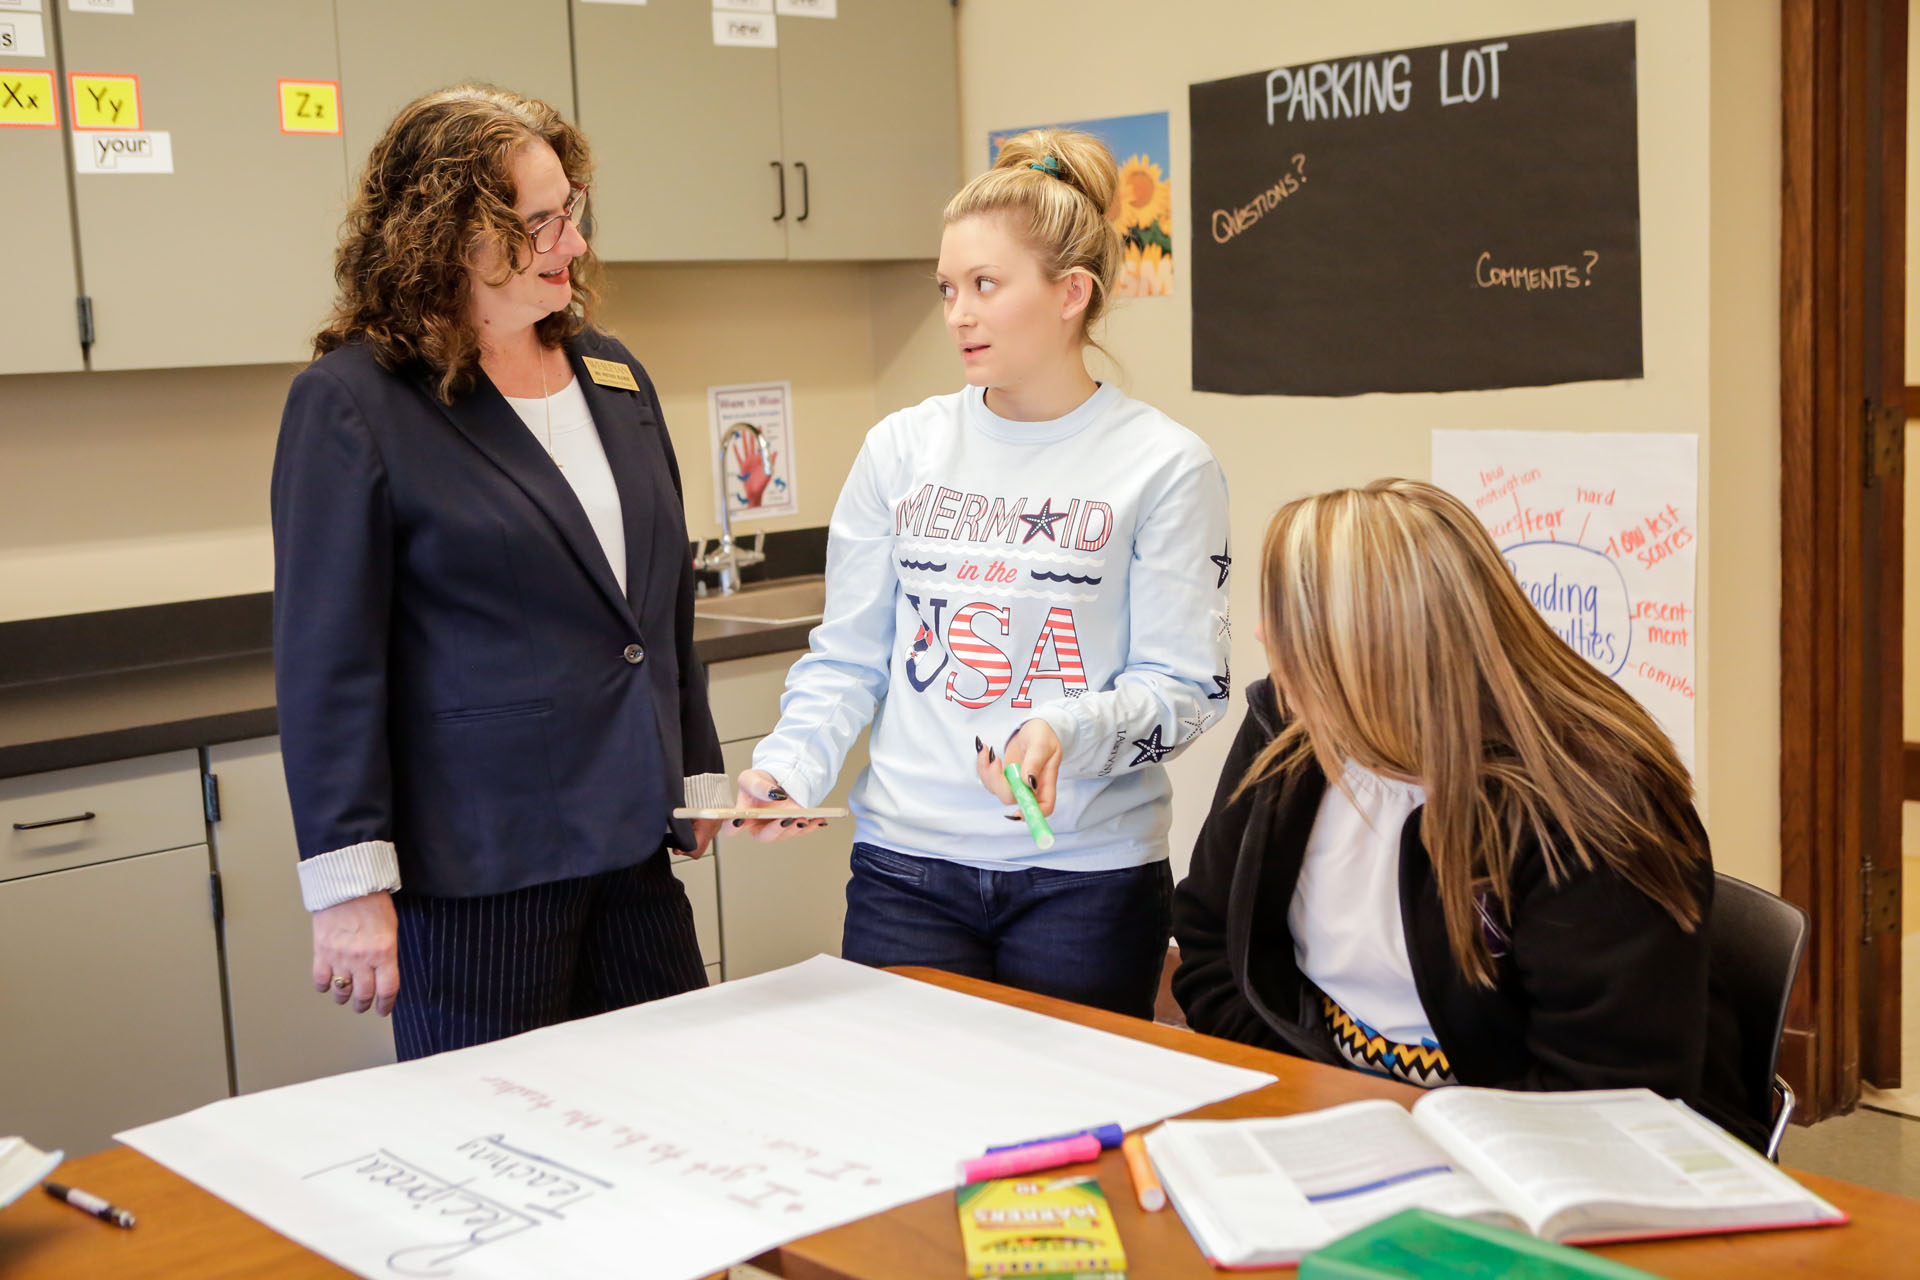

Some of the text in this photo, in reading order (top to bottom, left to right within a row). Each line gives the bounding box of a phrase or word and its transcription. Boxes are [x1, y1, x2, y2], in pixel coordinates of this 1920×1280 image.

[2, 82, 39, 109] Xx
[1266, 43, 1508, 126] PARKING LOT
[87, 86, 123, 123] Yy
[296, 92, 325, 119] Zz
[98, 138, 147, 164] your
[1211, 153, 1308, 244] QUESTIONS?
[1475, 251, 1599, 291] COMMENTS?
[1577, 487, 1616, 506] hard
[1525, 507, 1564, 533] fear
[1637, 525, 1693, 570] scores
[957, 560, 1018, 583] in the
[1648, 626, 1688, 648] ment
[905, 593, 1089, 710] USA
